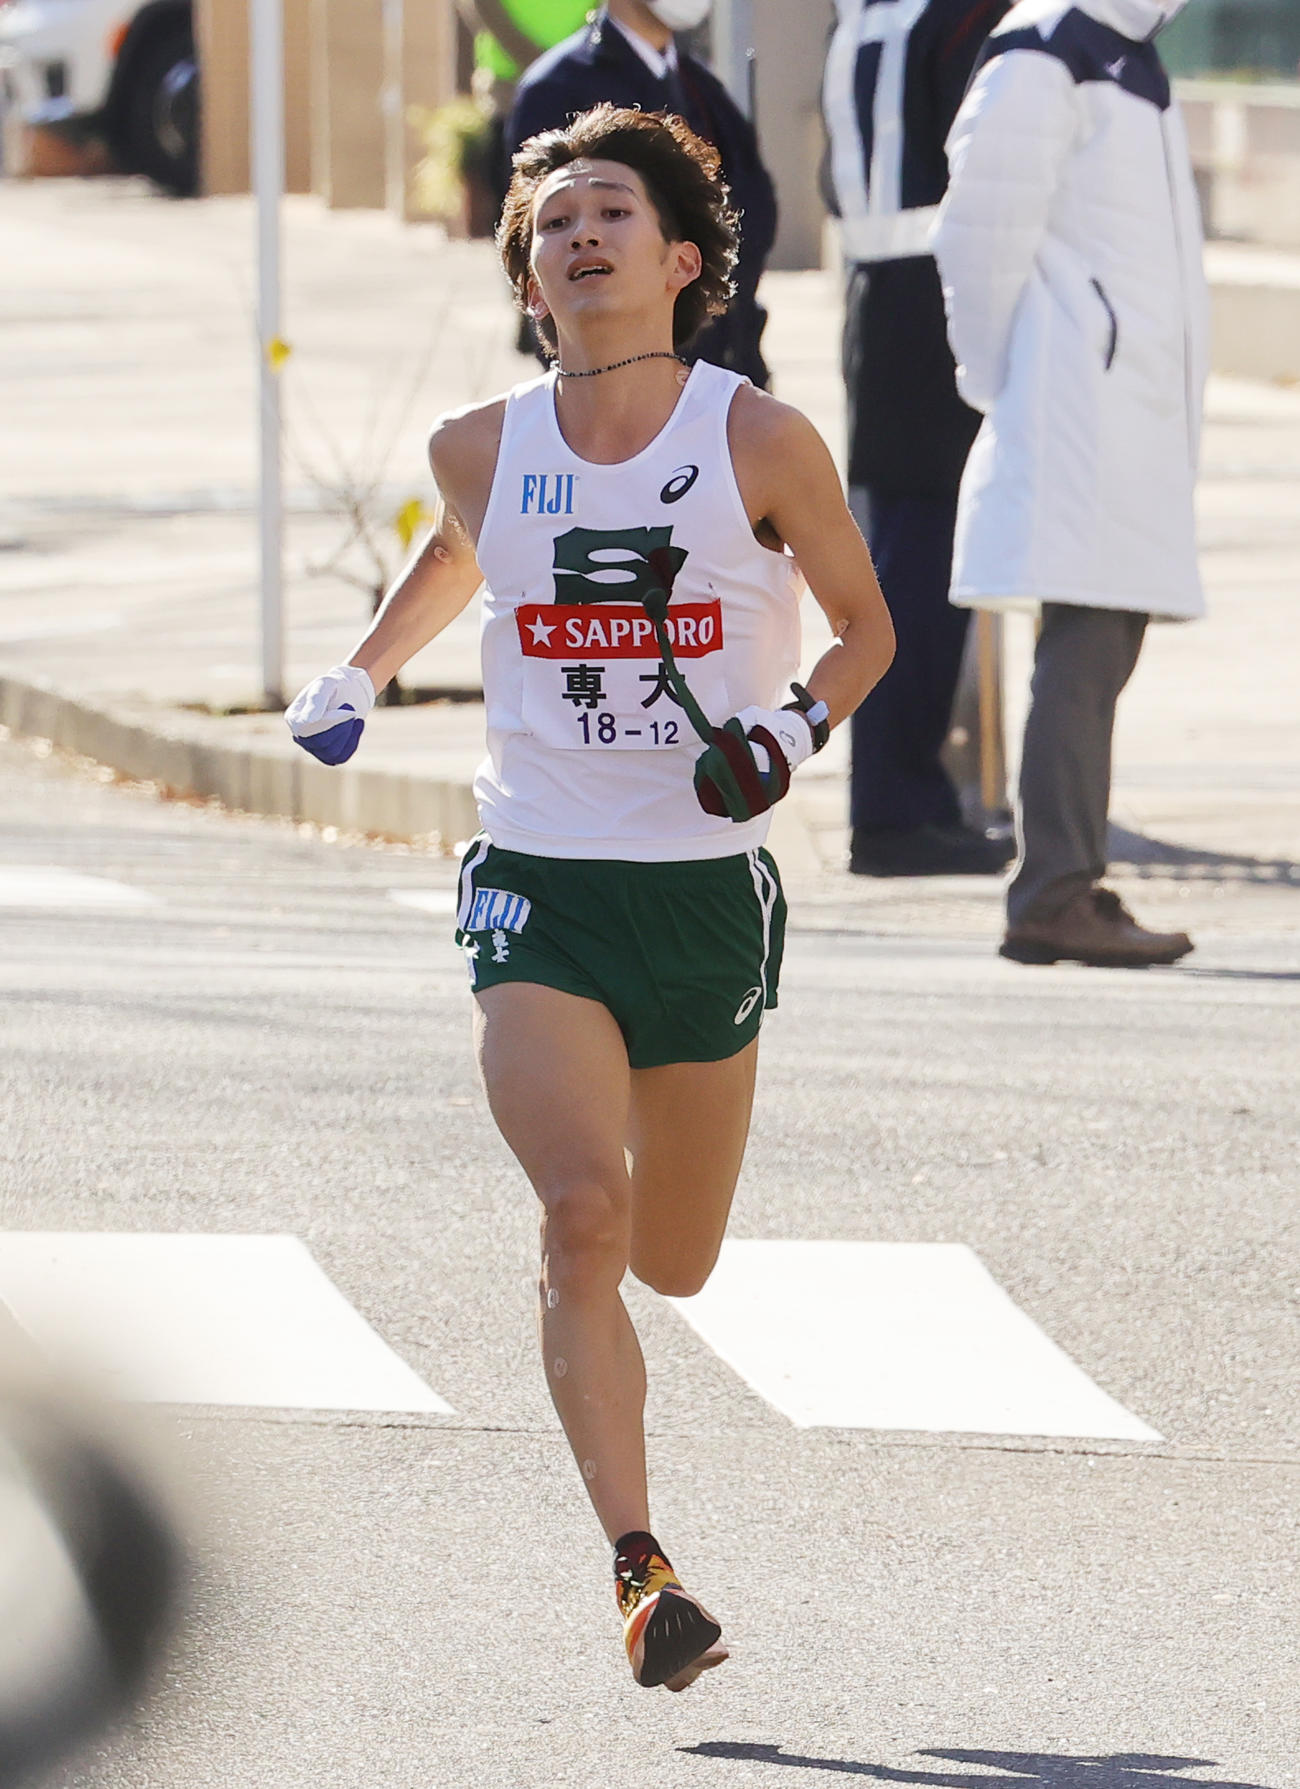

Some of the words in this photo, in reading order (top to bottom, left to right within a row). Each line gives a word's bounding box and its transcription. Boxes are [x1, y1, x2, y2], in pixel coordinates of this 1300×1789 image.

[520, 474, 574, 514] FIJI
[565, 615, 714, 648] SAPPORO
[577, 712, 679, 744] 18-12
[469, 890, 524, 931] FIJI
